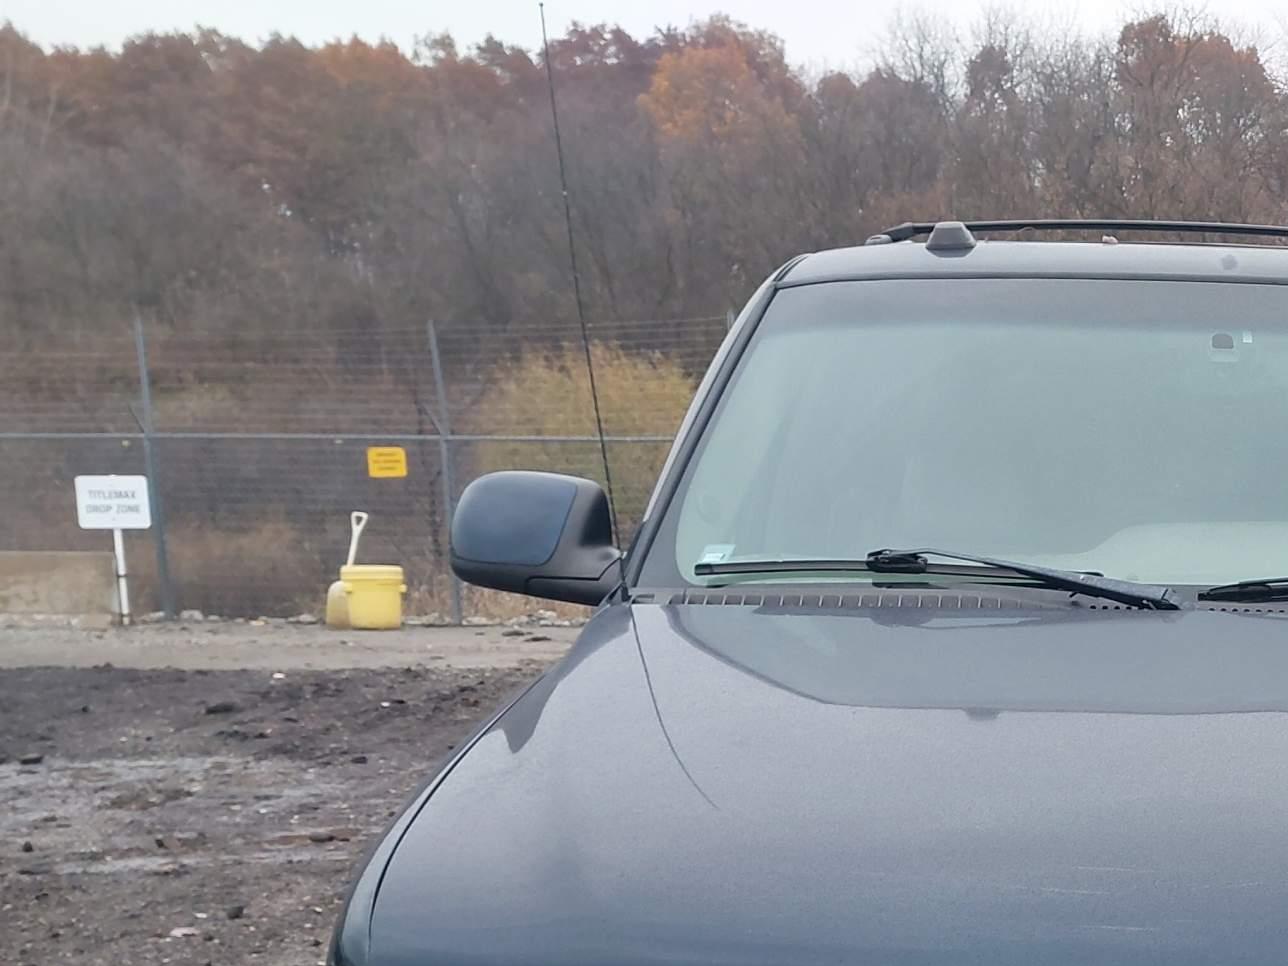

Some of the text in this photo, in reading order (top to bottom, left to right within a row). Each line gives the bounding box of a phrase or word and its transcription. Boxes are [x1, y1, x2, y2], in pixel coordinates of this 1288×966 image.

[87, 489, 137, 500] TITLEMAX
[85, 504, 140, 514] DROP ZONE
